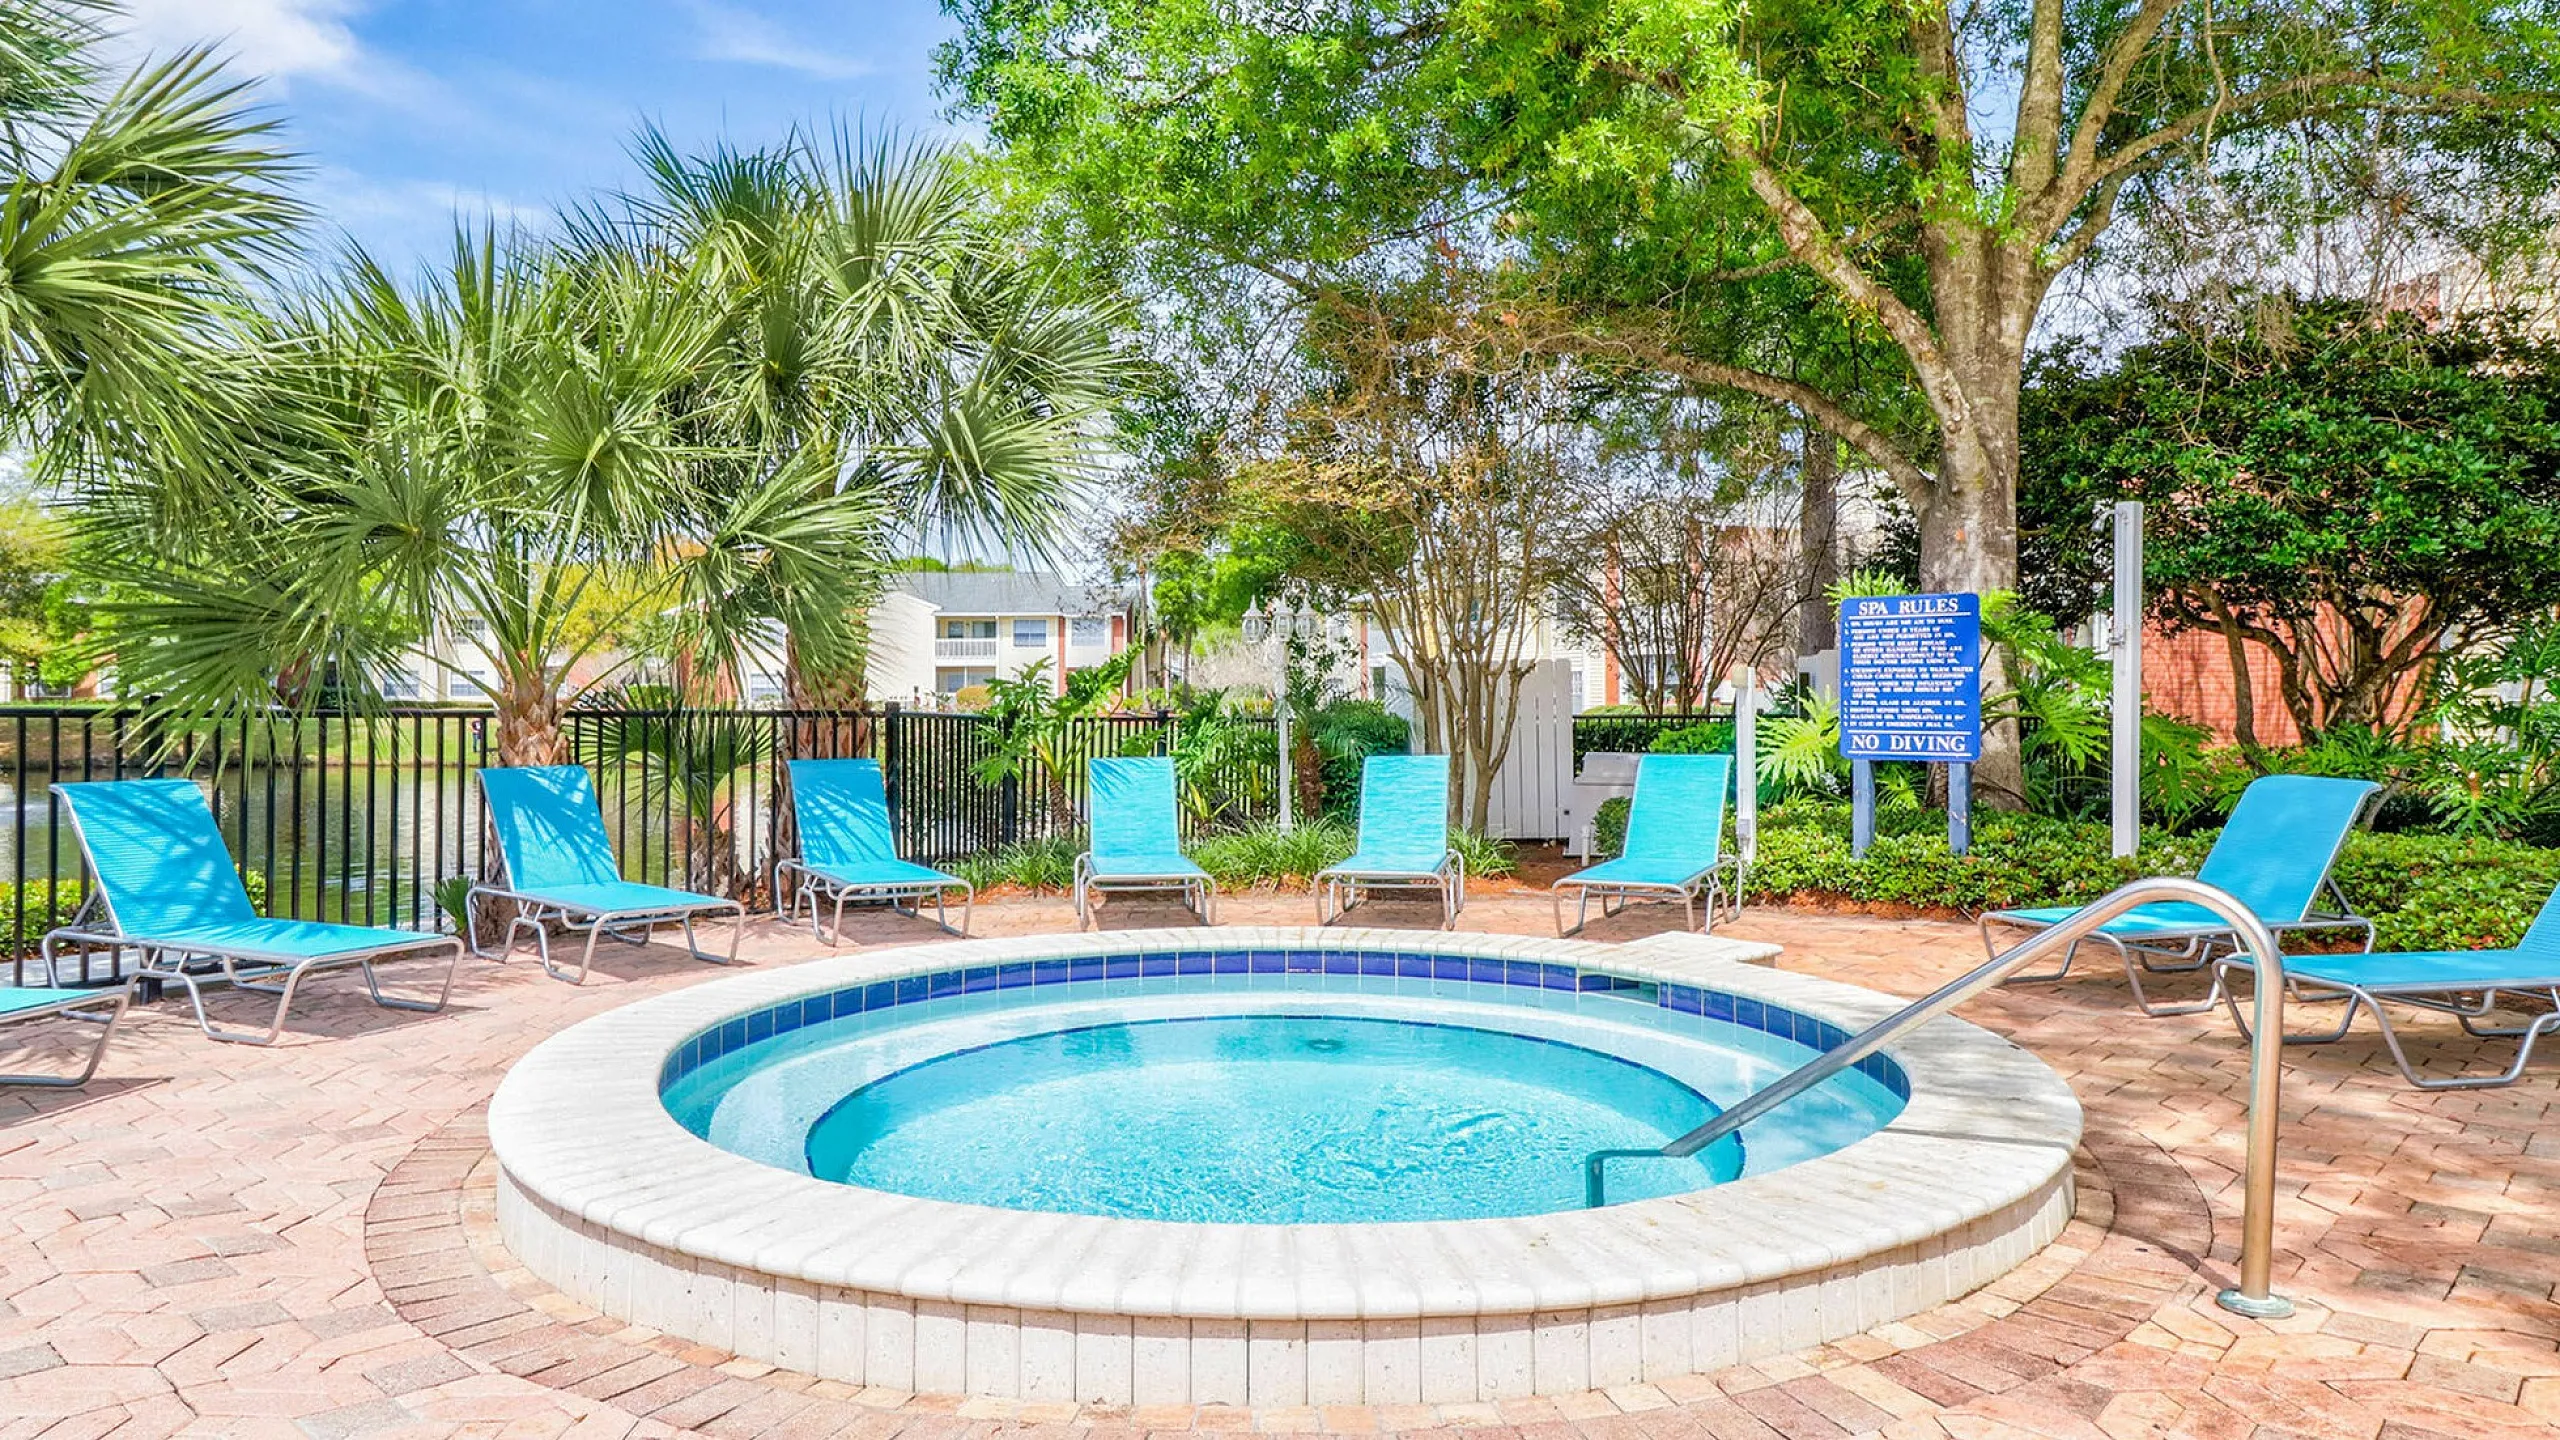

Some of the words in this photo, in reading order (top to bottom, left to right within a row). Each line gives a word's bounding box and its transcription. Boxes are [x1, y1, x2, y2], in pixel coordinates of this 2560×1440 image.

[1858, 601, 1888, 615] SPA
[1899, 598, 1958, 613] RULES
[1851, 734, 1879, 750] NO
[1889, 735, 1966, 752] DIVING
